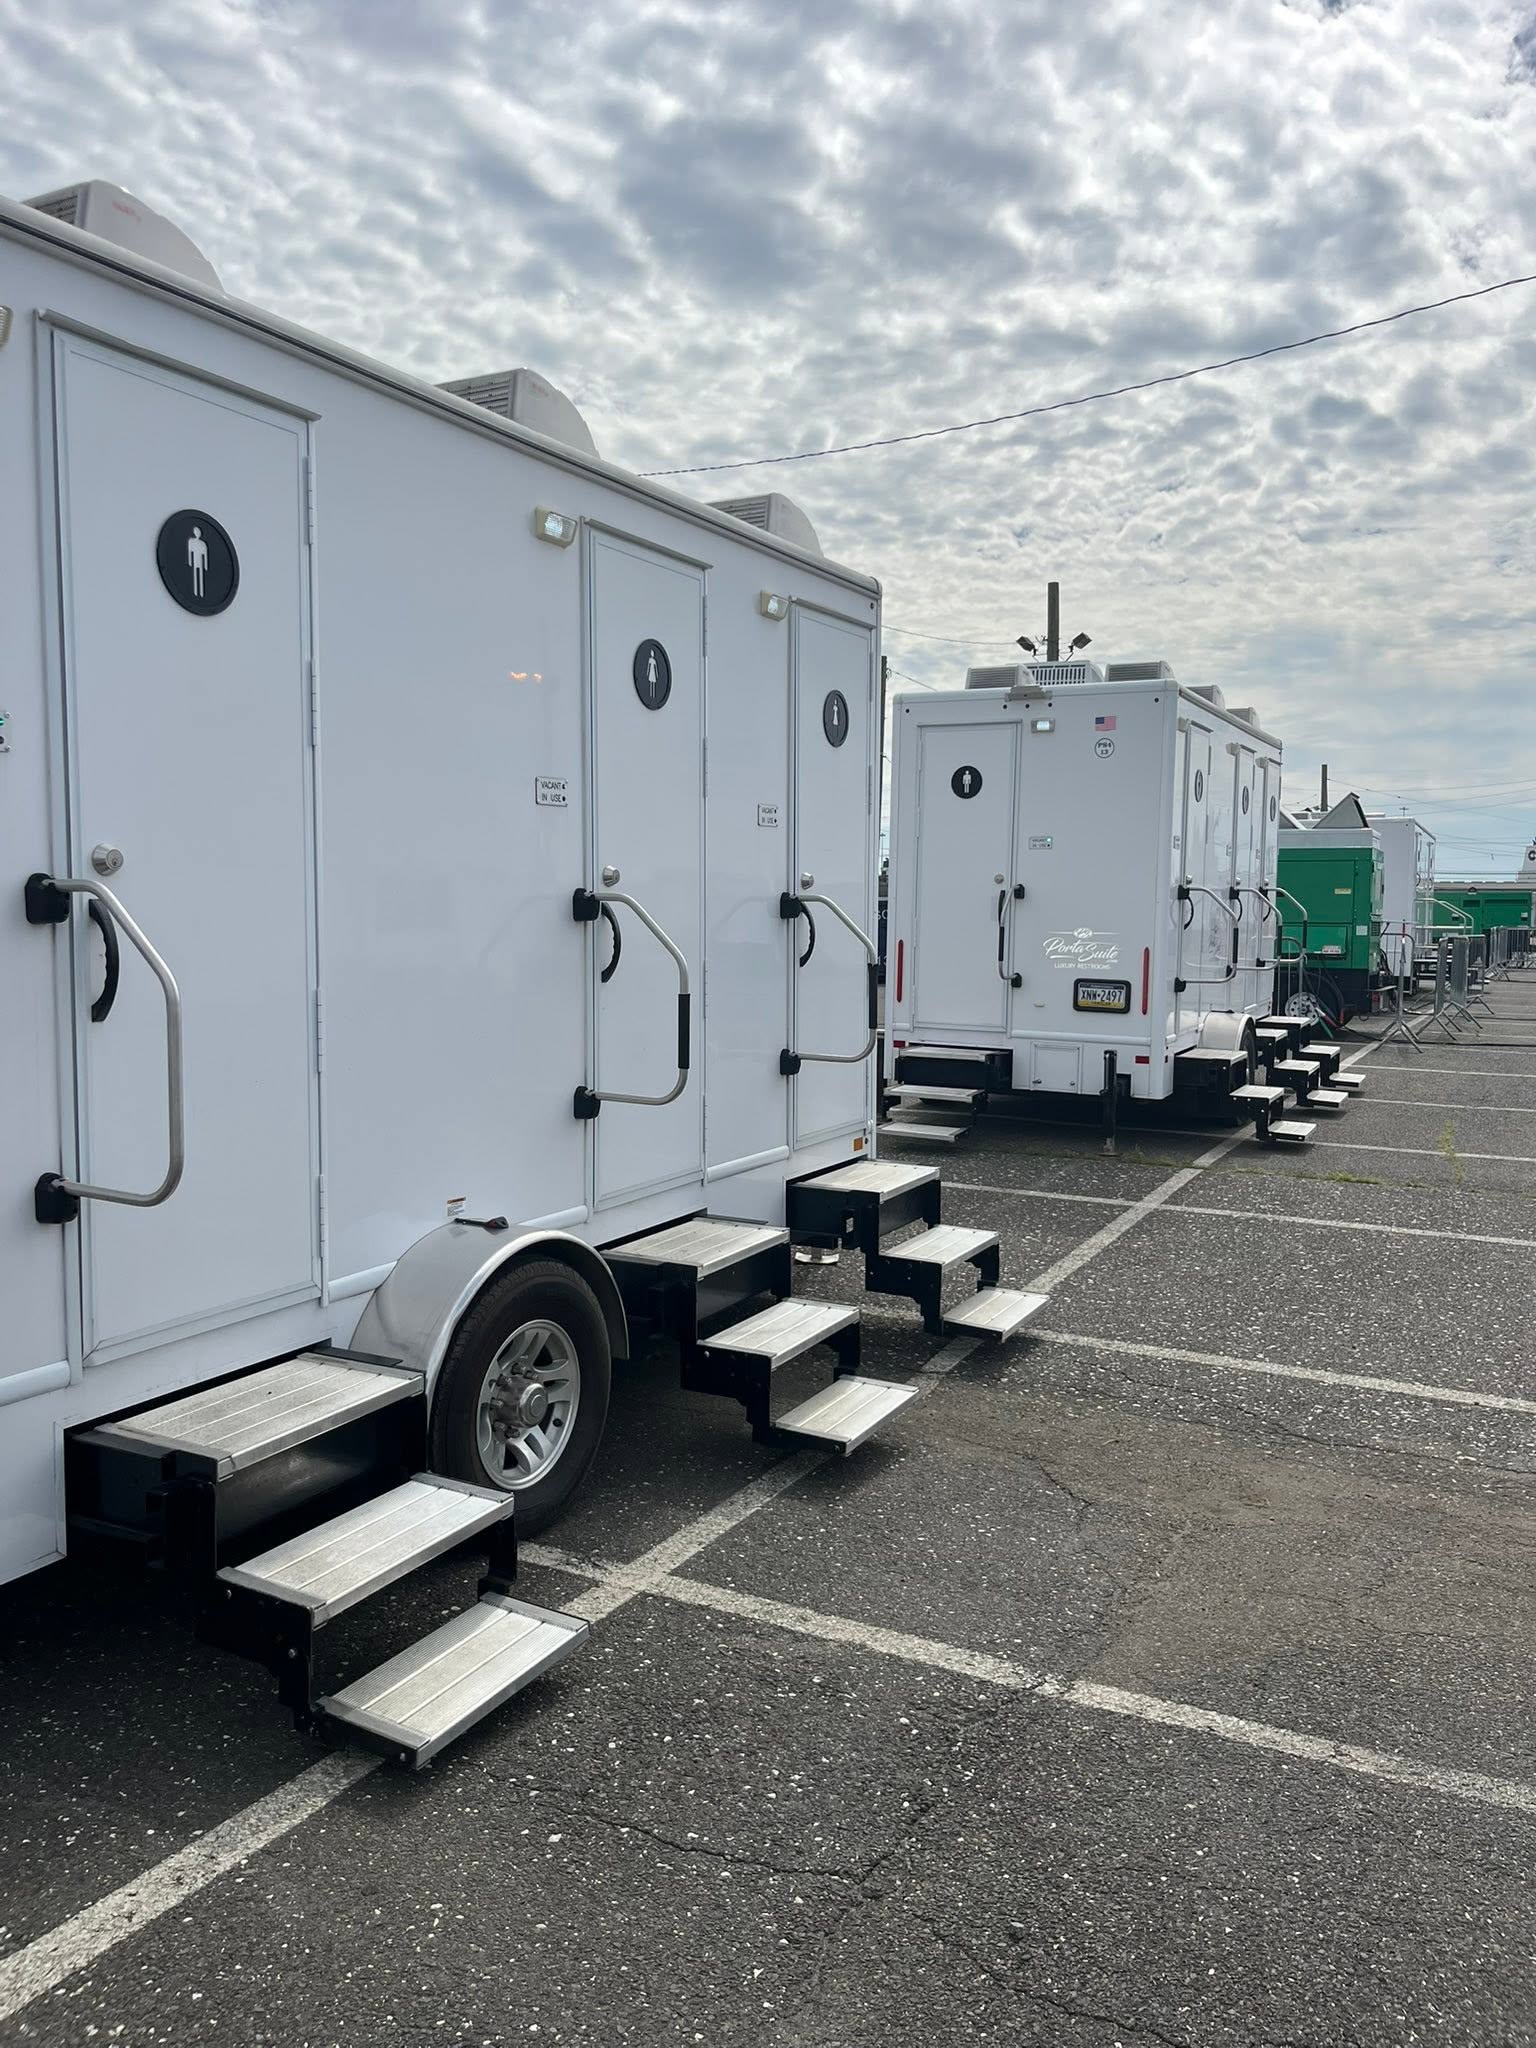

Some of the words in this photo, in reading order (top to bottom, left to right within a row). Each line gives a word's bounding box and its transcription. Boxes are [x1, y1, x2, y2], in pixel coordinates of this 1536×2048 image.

[540, 781, 561, 790] VACANT
[541, 793, 548, 801] IN
[550, 794, 562, 803] USE
[1042, 936, 1083, 956] Porta
[1078, 942, 1119, 962] Suite
